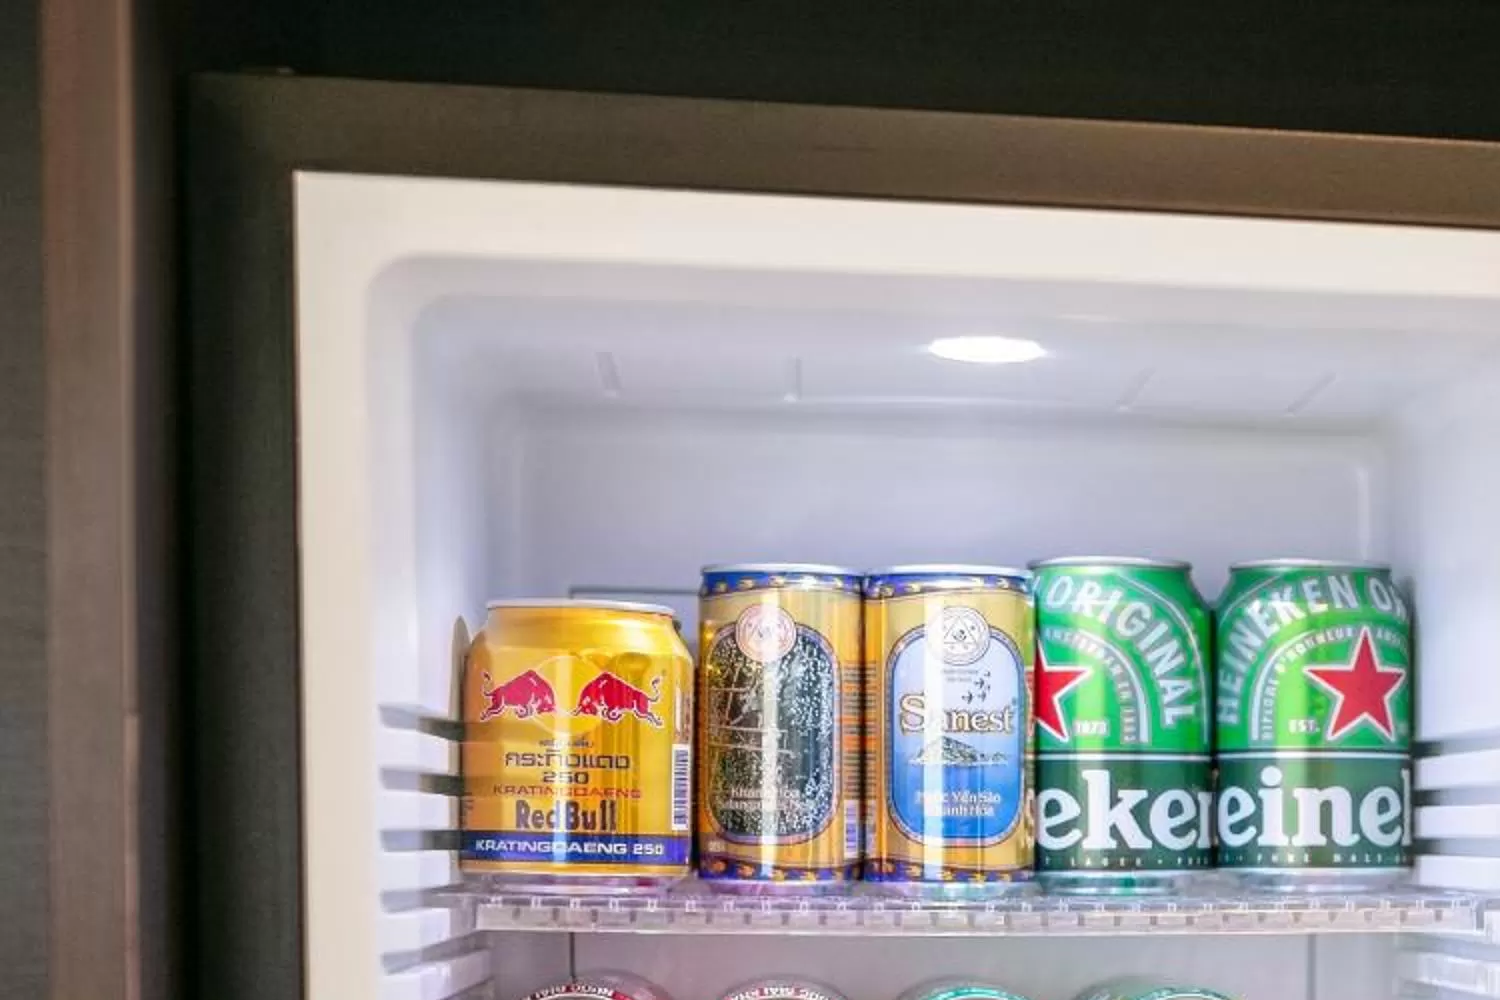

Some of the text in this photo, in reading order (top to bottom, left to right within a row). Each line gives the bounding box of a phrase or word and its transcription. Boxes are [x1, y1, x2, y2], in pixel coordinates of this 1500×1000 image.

[1046, 575, 1194, 726] ORIGINAL
[1218, 574, 1359, 725] HEINEKEN
[542, 771, 589, 784] 250
[475, 838, 665, 856] KRATINGDAENG 250
